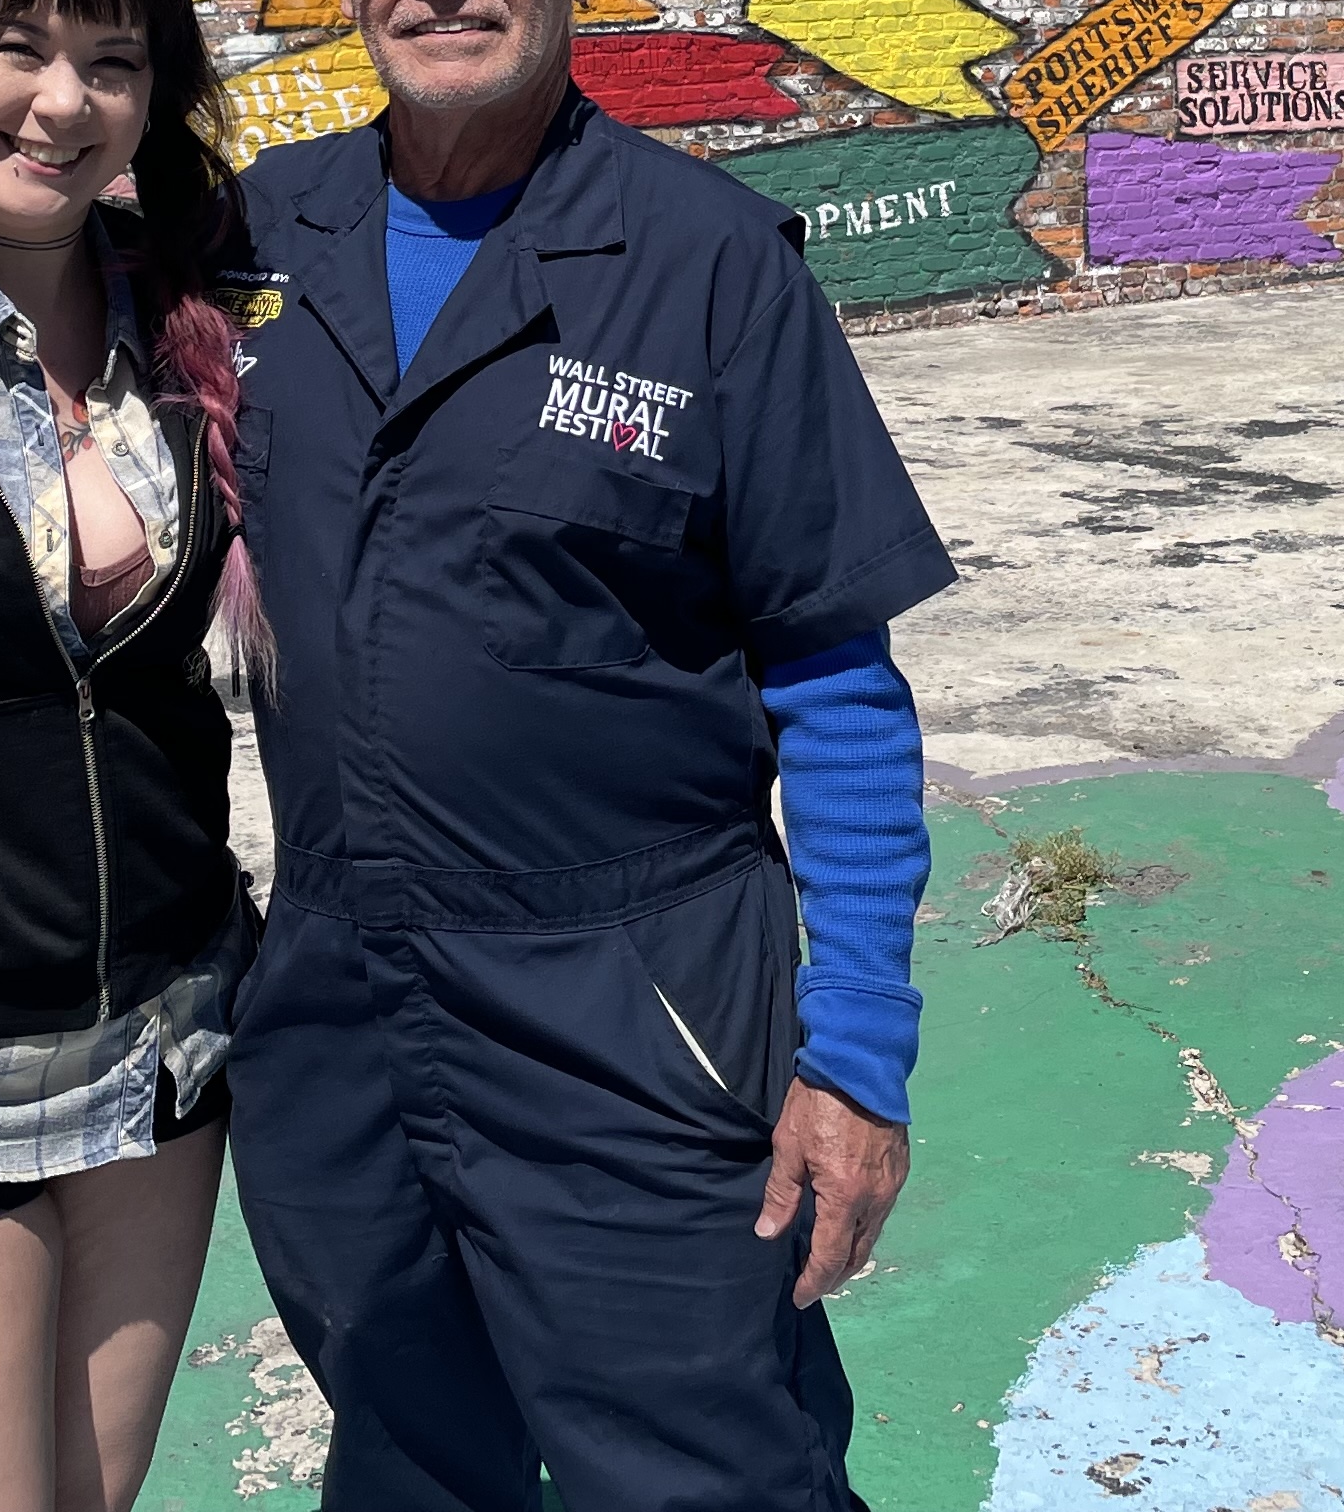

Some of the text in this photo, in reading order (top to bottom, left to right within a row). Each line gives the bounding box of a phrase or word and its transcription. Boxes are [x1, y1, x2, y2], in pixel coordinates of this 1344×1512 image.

[1186, 60, 1327, 94] SERVICE
[546, 377, 670, 439] MURAL
[548, 354, 694, 410] WALL STREET
